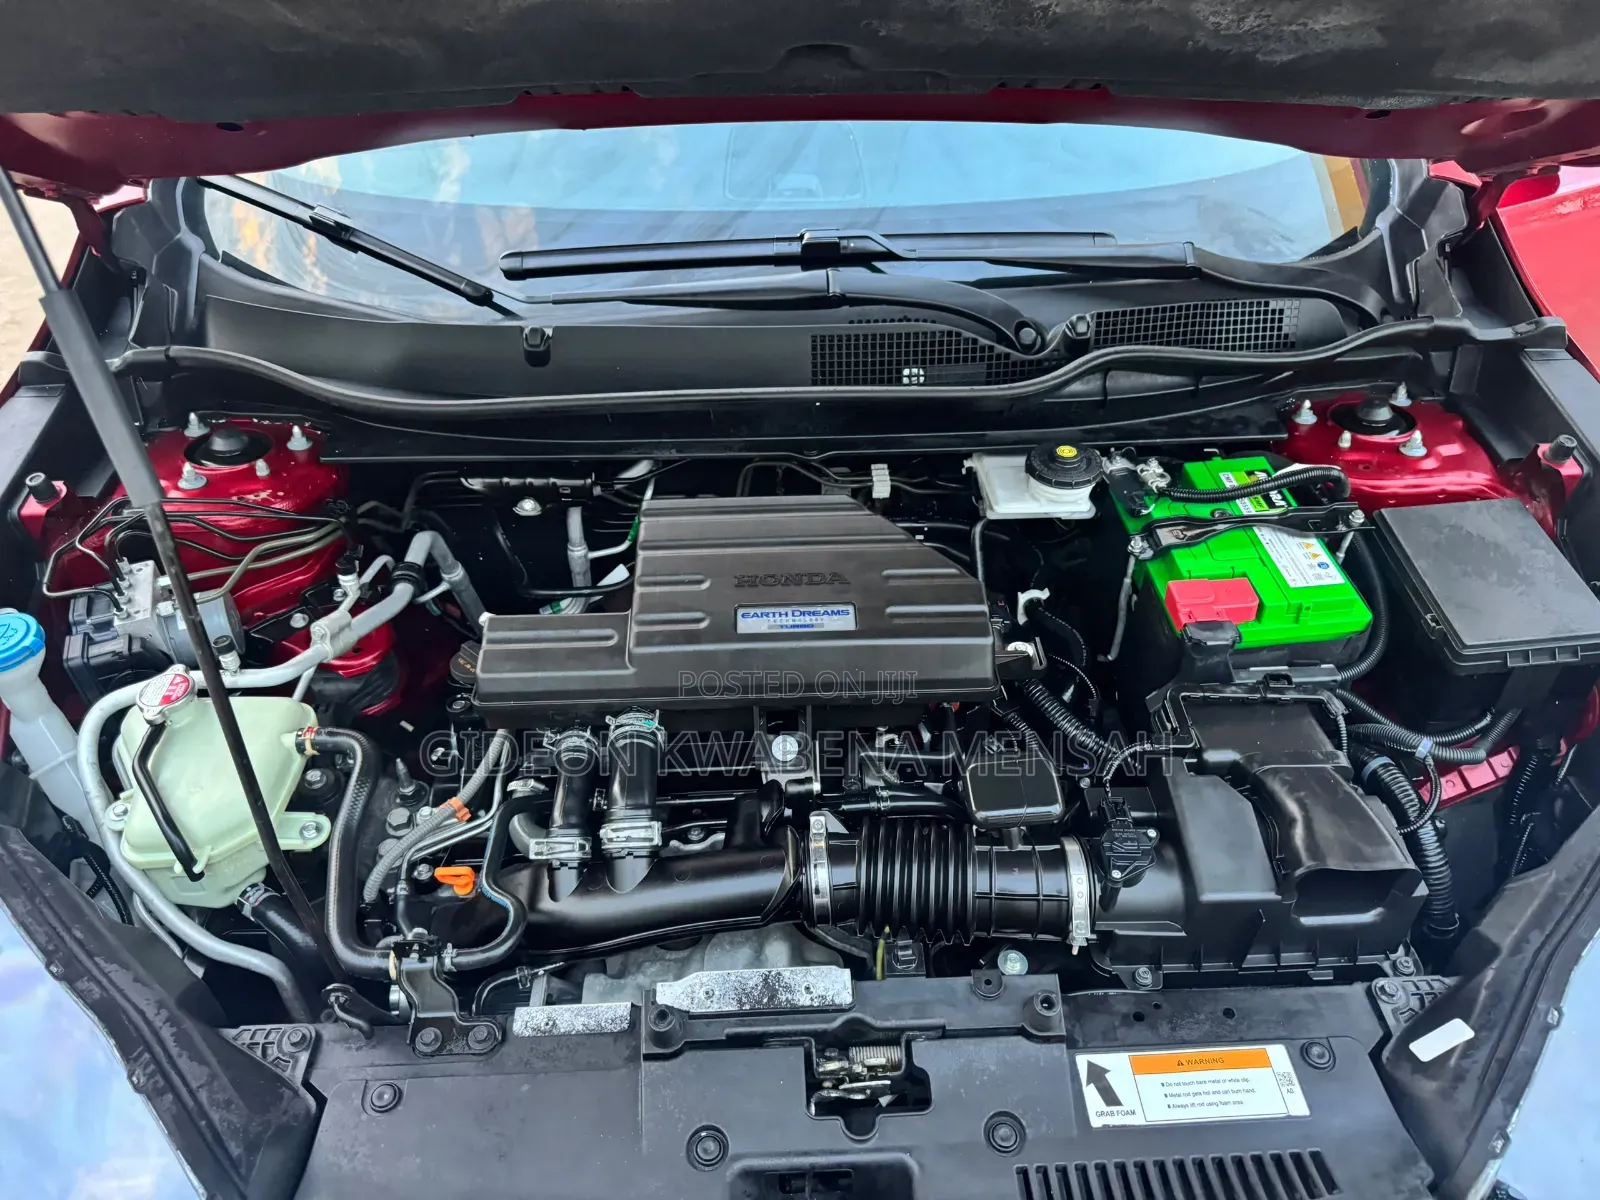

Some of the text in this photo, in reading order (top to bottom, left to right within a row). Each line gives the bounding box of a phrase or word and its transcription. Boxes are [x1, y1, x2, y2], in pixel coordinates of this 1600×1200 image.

[734, 572, 852, 588] HONDA
[741, 609, 850, 619] EARTH DREAMS
[1186, 1057, 1225, 1066] WARNING
[1095, 1109, 1136, 1118] GRAB FOAM
